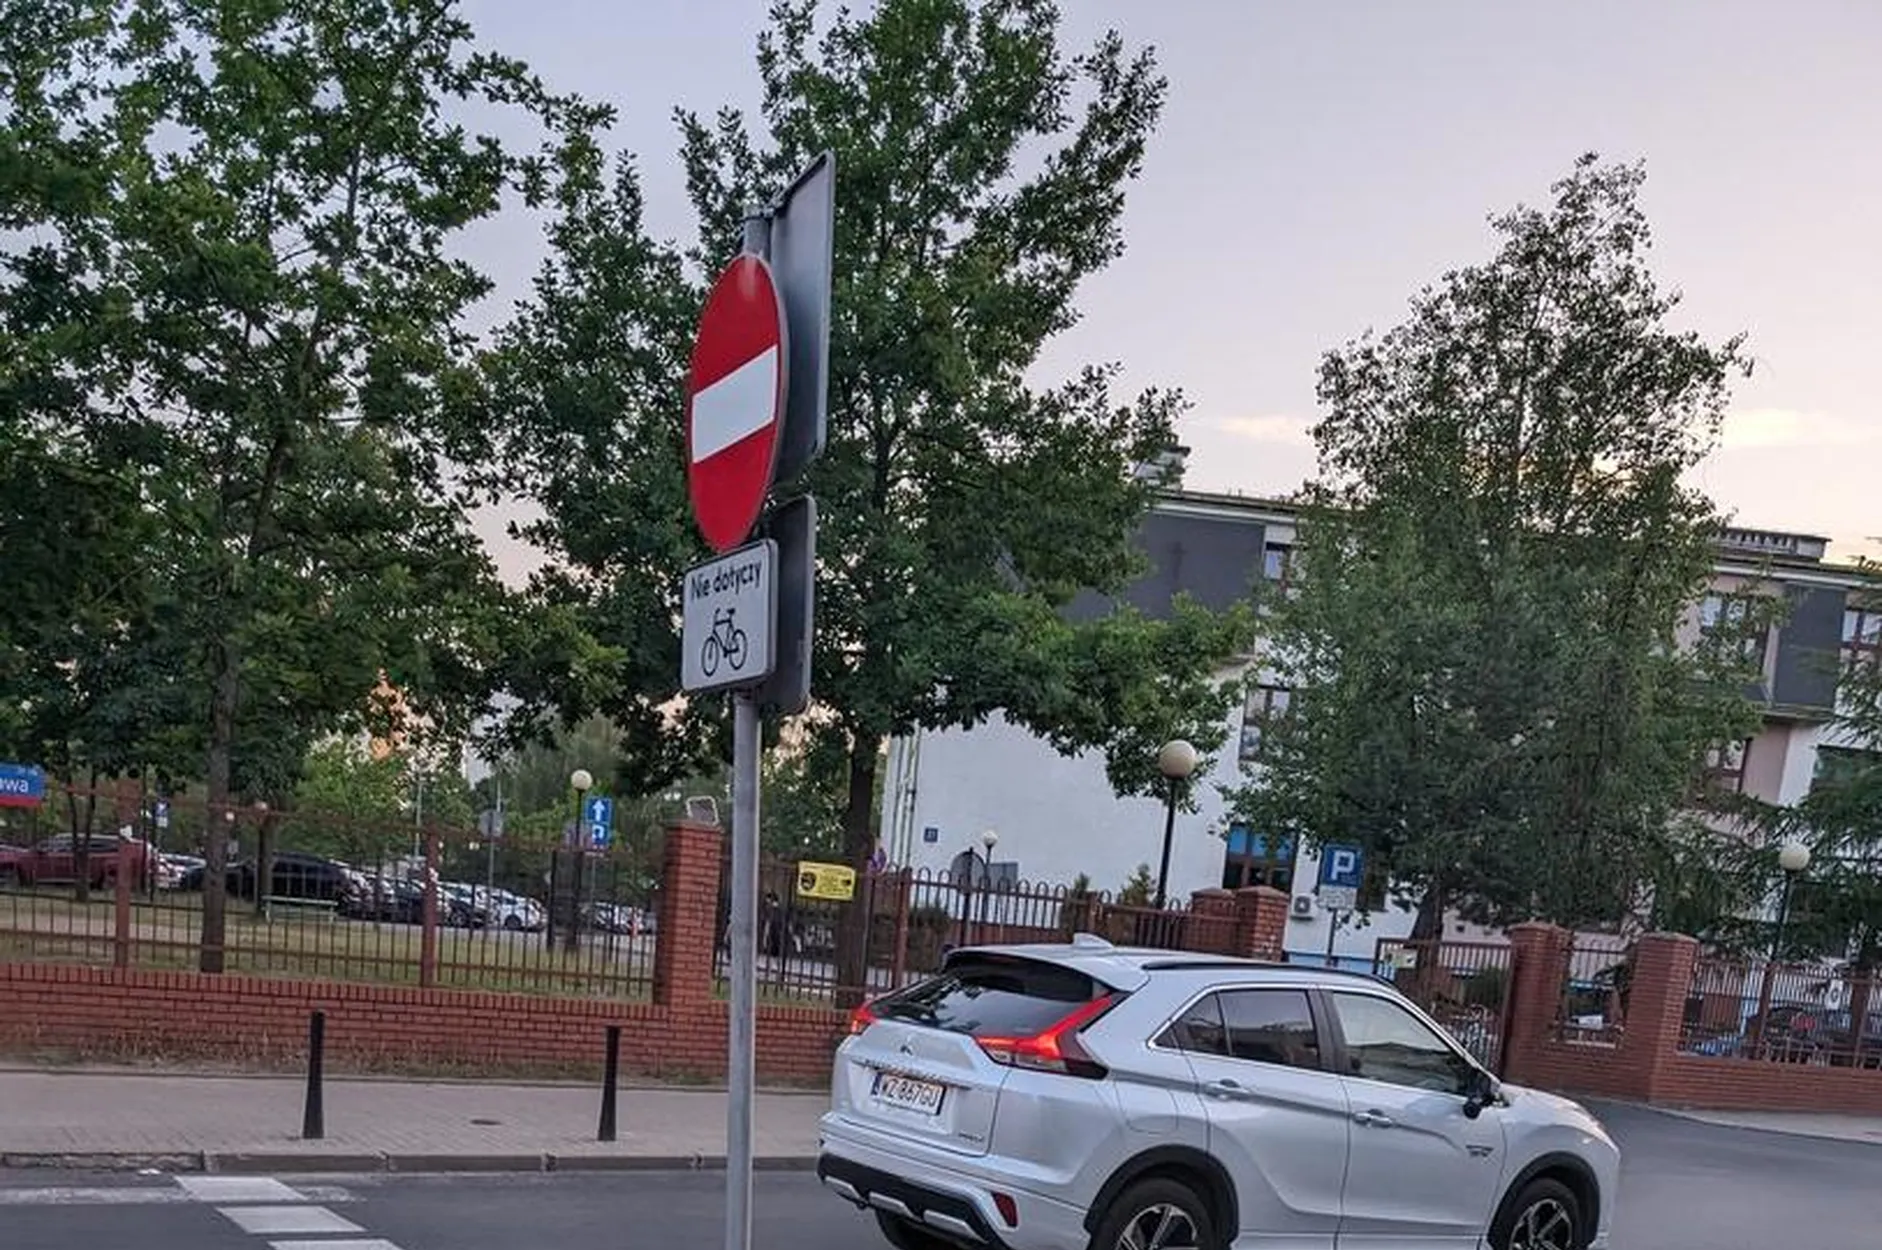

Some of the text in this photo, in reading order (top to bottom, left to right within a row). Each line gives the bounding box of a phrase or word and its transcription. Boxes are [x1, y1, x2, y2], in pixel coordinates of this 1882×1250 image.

[691, 562, 762, 601] Nie dotyczy
[1331, 850, 1355, 880] P
